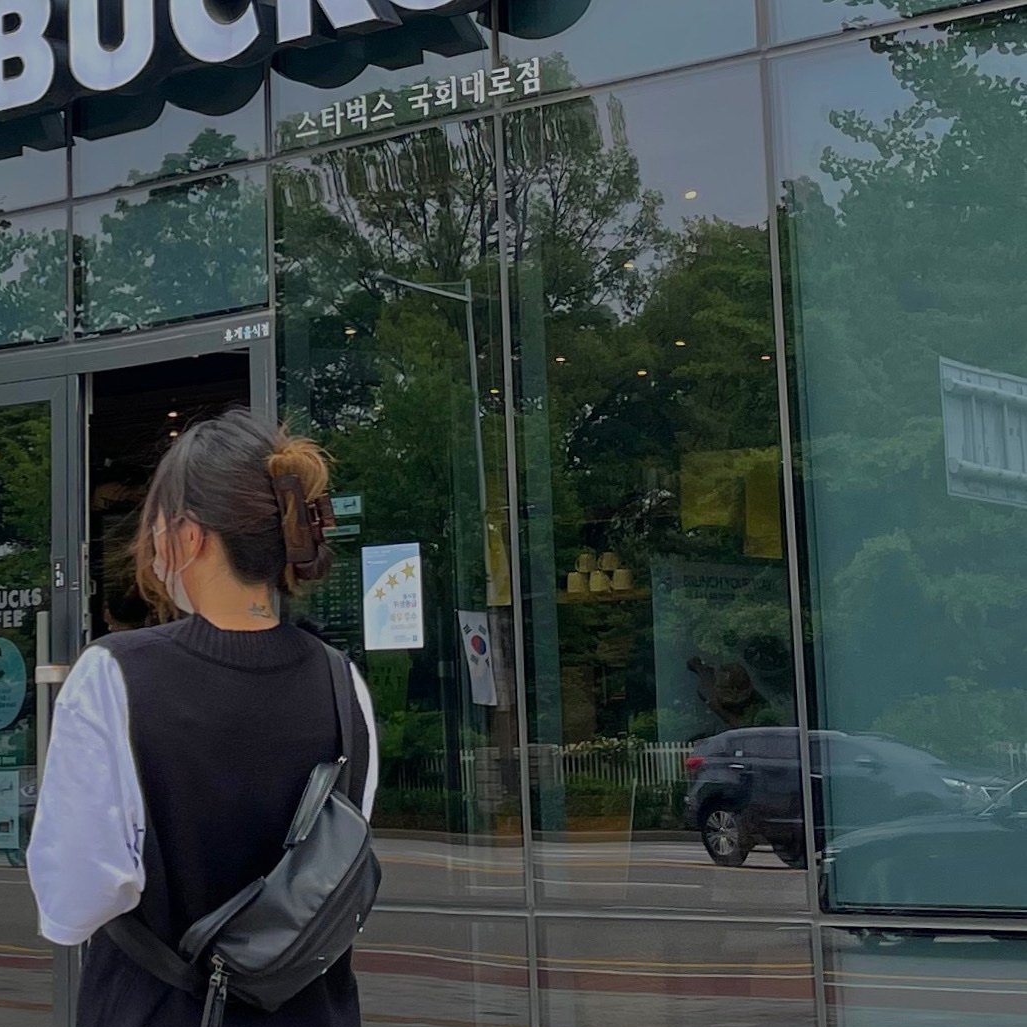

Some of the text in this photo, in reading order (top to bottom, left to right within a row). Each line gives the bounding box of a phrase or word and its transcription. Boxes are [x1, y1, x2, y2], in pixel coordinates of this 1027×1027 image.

[295, 57, 542, 138] 스타벅스 국회대로점
[223, 321, 270, 342] 휴게음식점
